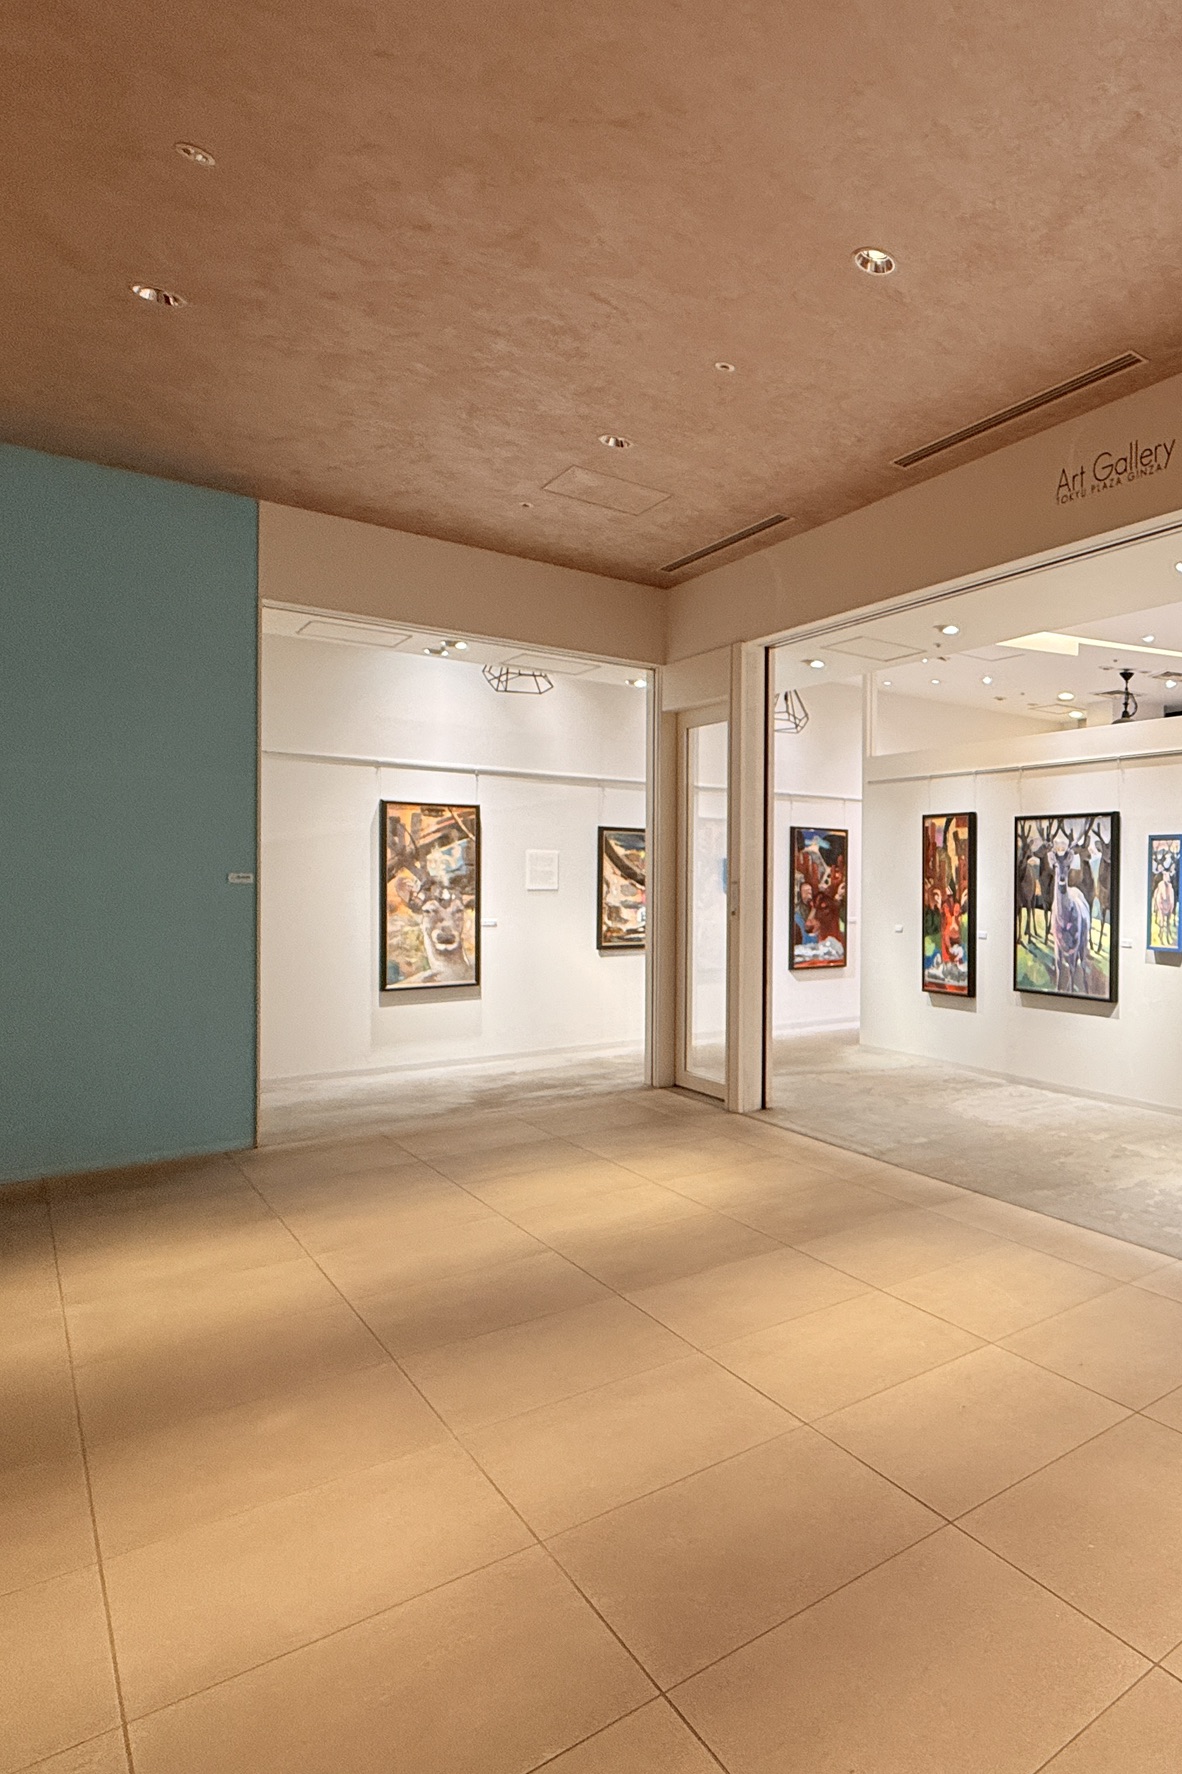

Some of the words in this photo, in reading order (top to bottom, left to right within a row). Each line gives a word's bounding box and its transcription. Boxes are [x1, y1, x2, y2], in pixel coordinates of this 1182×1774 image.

[1056, 465, 1086, 497] Art
[1092, 438, 1177, 482] Gallery
[1056, 490, 1087, 506] TOKYU
[1091, 478, 1123, 494] PLAZA
[1127, 463, 1163, 482] GINZA
